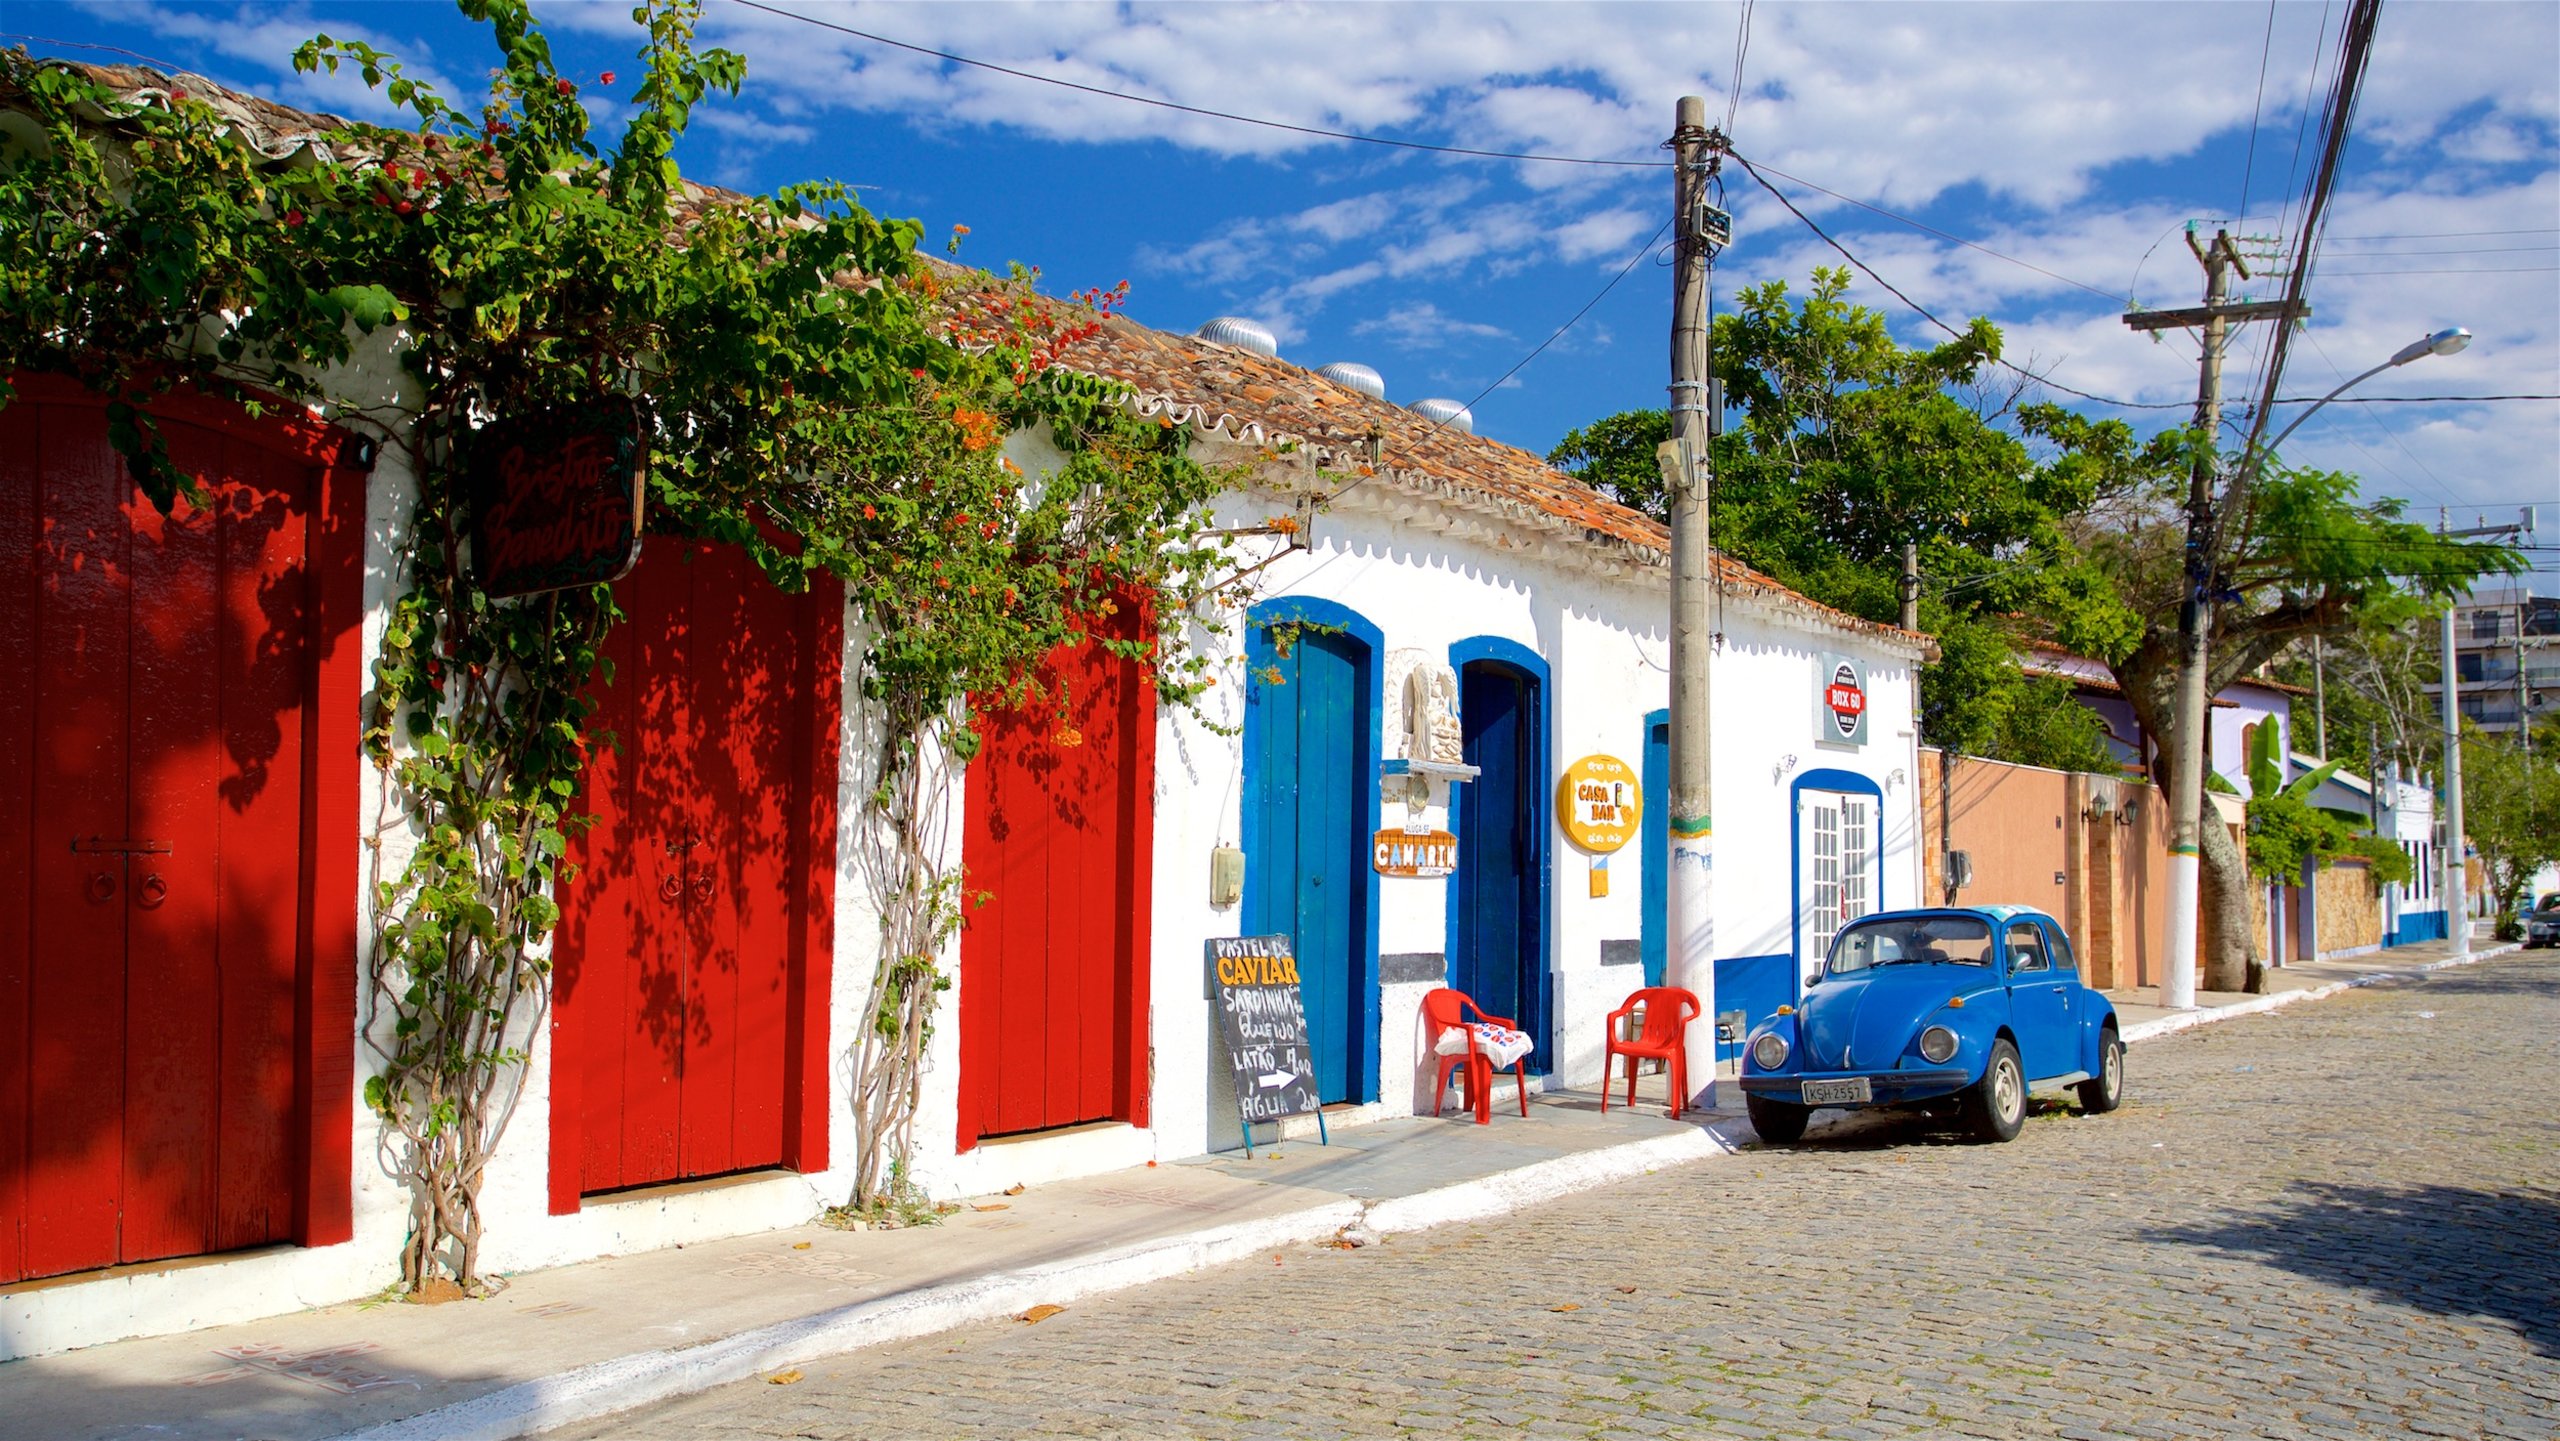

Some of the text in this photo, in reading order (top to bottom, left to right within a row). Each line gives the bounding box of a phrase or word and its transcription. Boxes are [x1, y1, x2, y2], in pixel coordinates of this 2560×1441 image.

[483, 497, 633, 586] Benedito
[1831, 689, 1861, 710] BOX 60
[1578, 784, 1609, 803] CASA
[1591, 804, 1615, 821] BAR
[1375, 843, 1457, 867] CAMARIM
[1216, 939, 1292, 959] PASTEL DE
[1217, 956, 1301, 985] CAVIAR
[1241, 1082, 1290, 1119] ÁGUA
[1809, 1087, 1861, 1100] KSH-2557
